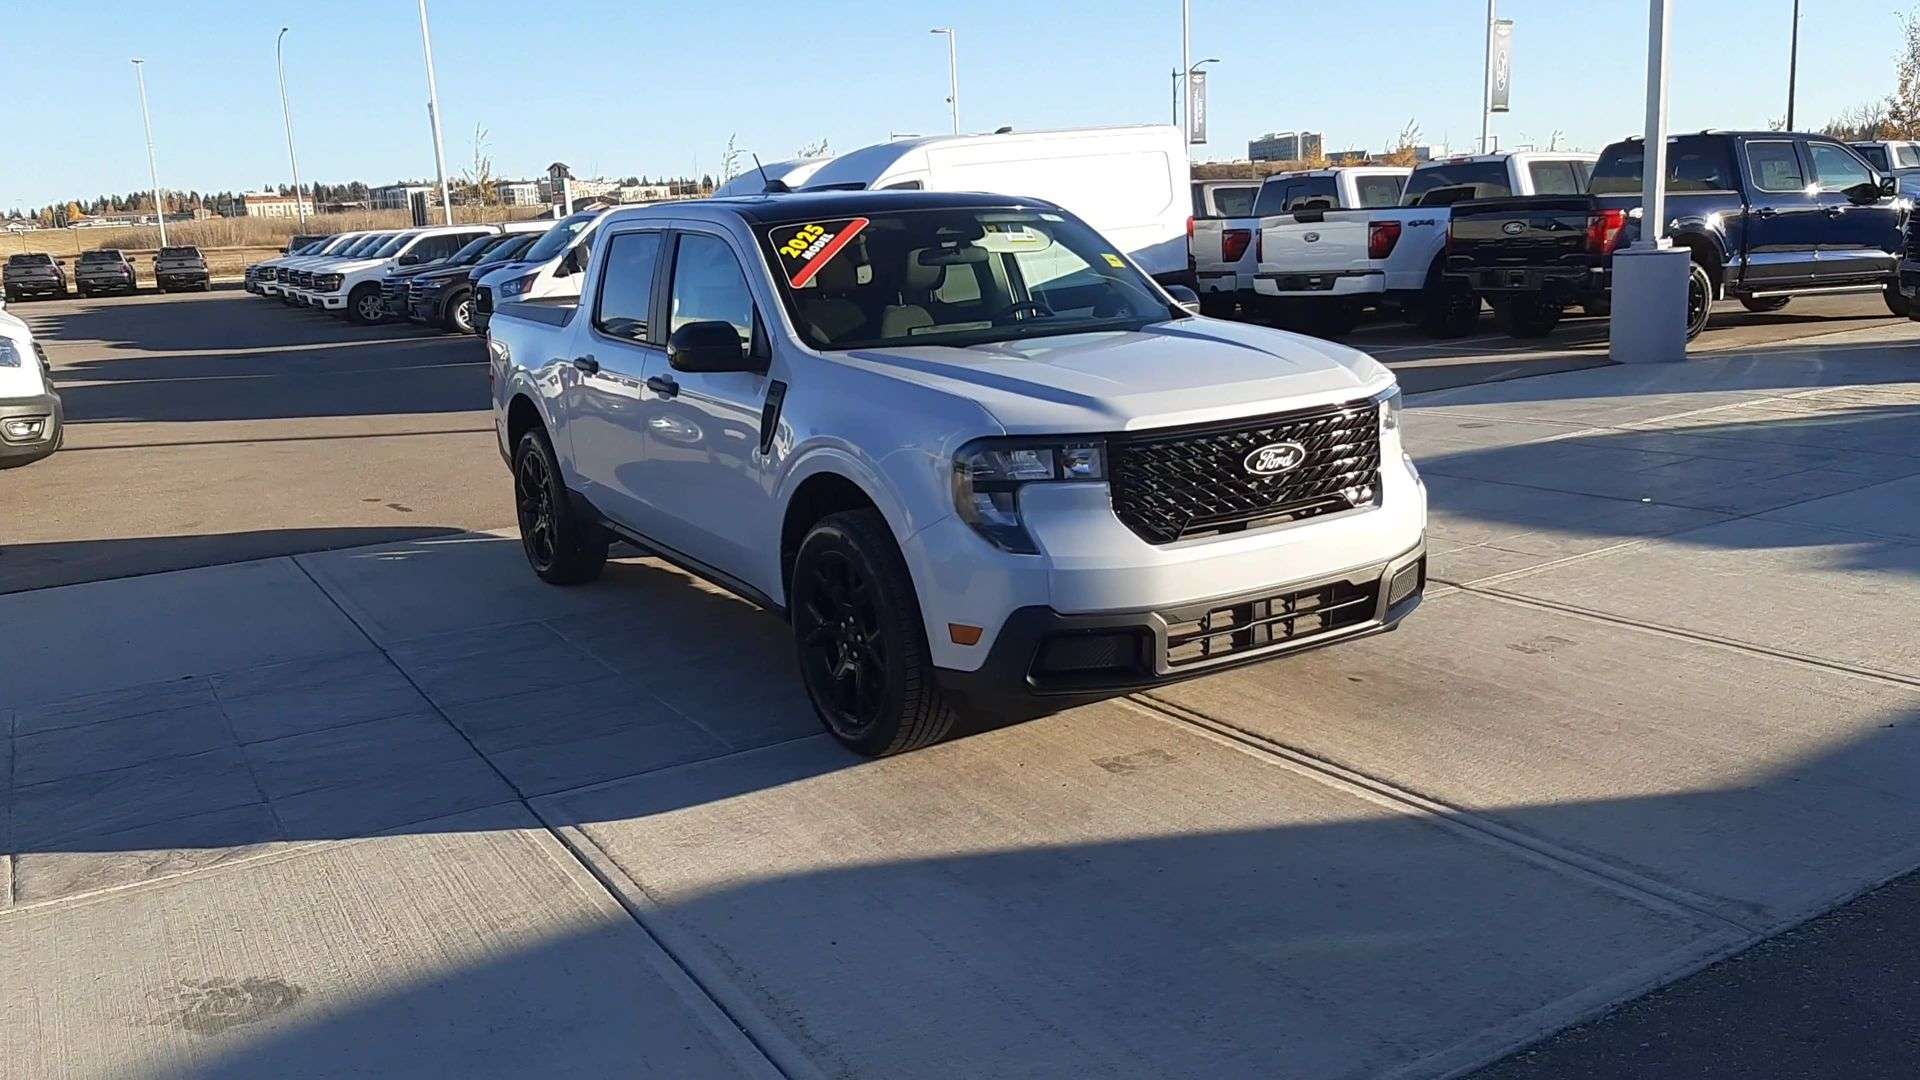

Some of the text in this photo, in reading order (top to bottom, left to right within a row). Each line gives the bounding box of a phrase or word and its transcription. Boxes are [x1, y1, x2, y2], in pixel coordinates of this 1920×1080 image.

[780, 224, 825, 259] 2025
[801, 233, 835, 261] MODEL
[1255, 447, 1295, 471] Ford
